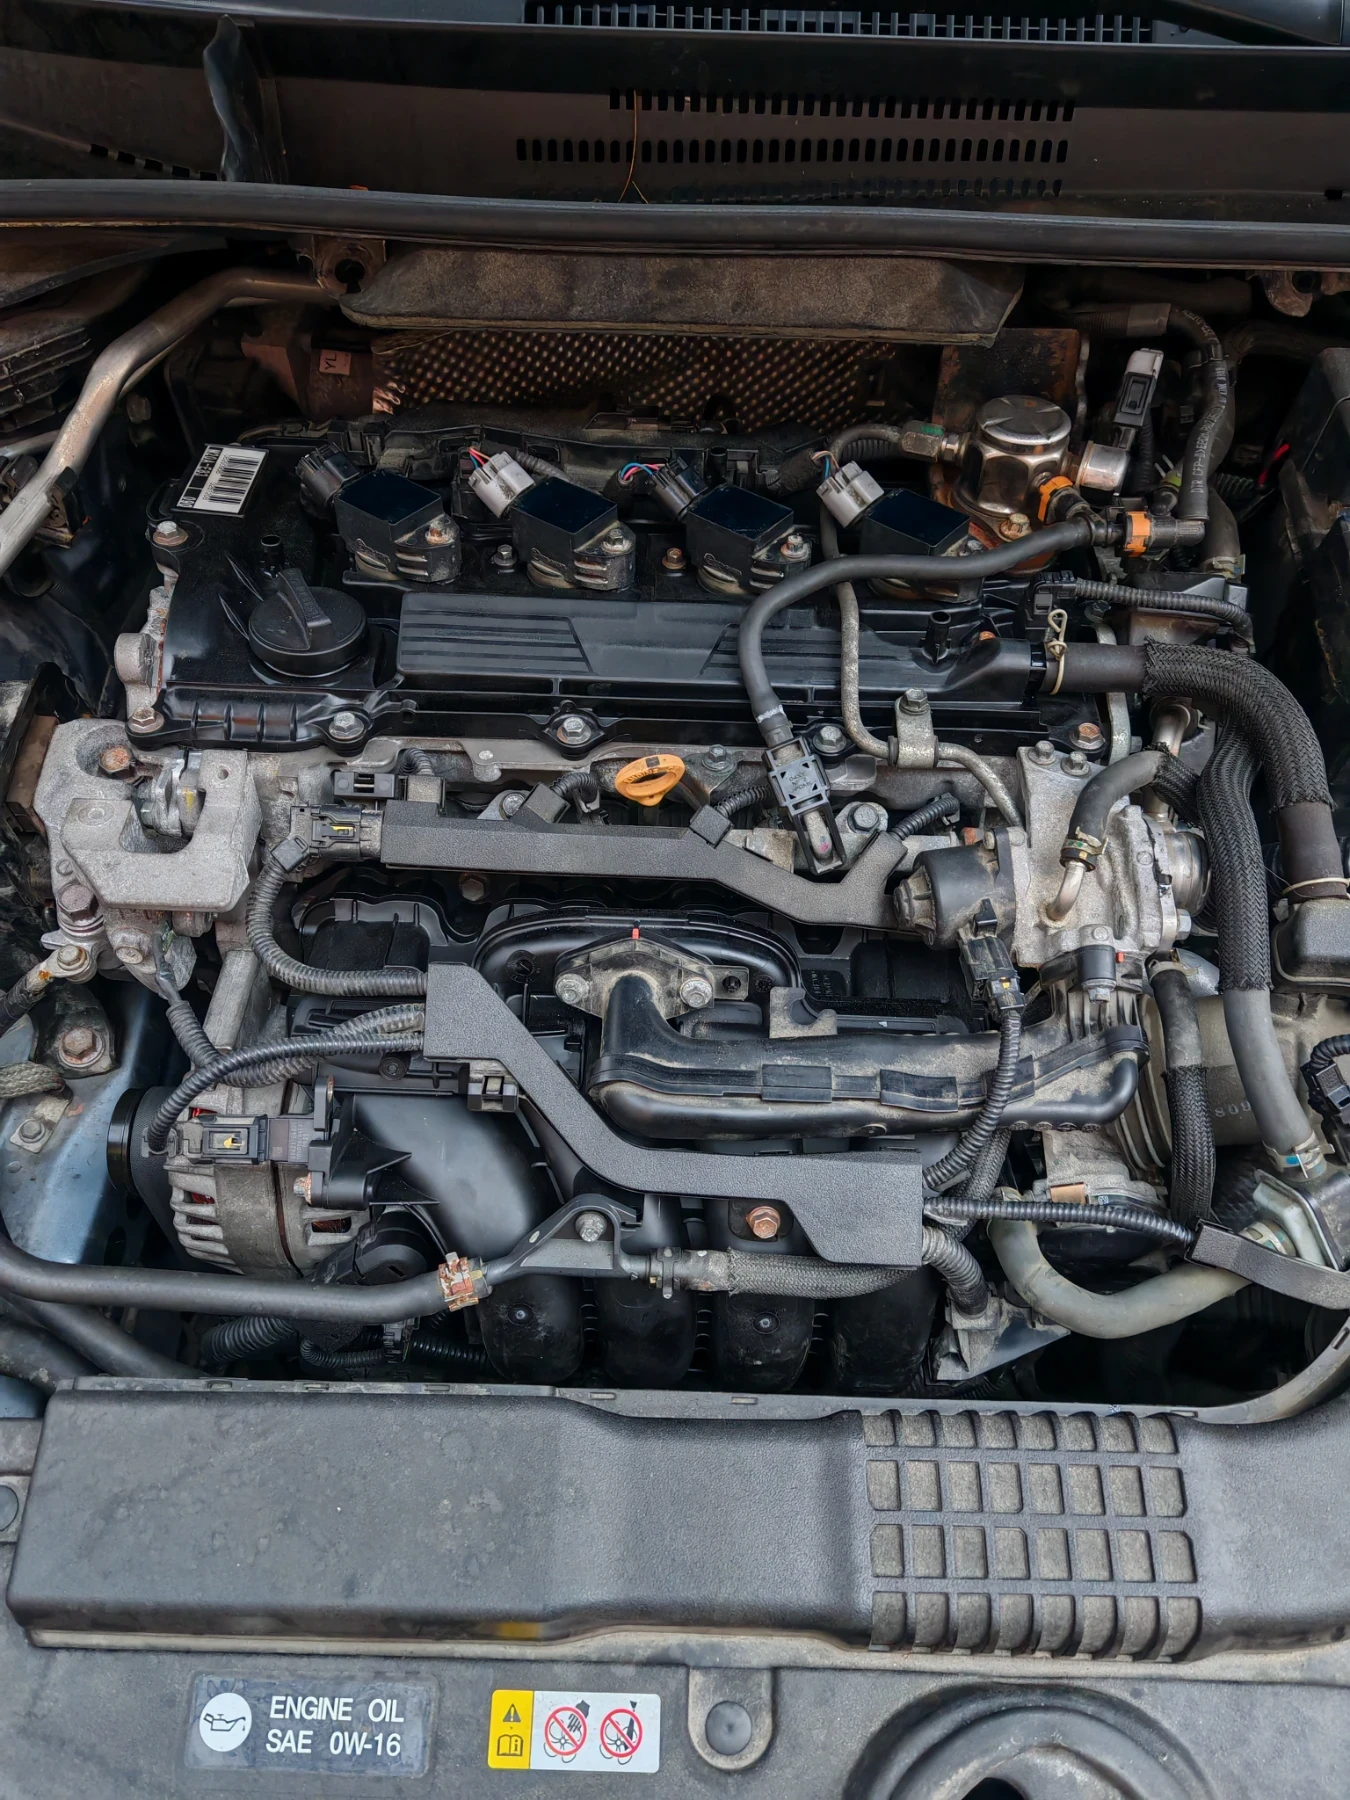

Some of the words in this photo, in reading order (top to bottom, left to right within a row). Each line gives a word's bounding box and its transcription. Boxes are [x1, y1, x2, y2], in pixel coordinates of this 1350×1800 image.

[270, 1696, 354, 1721] ENGINE
[368, 1698, 405, 1723] OIL
[265, 1729, 313, 1754] SAE
[329, 1731, 402, 1757] 0W-16
